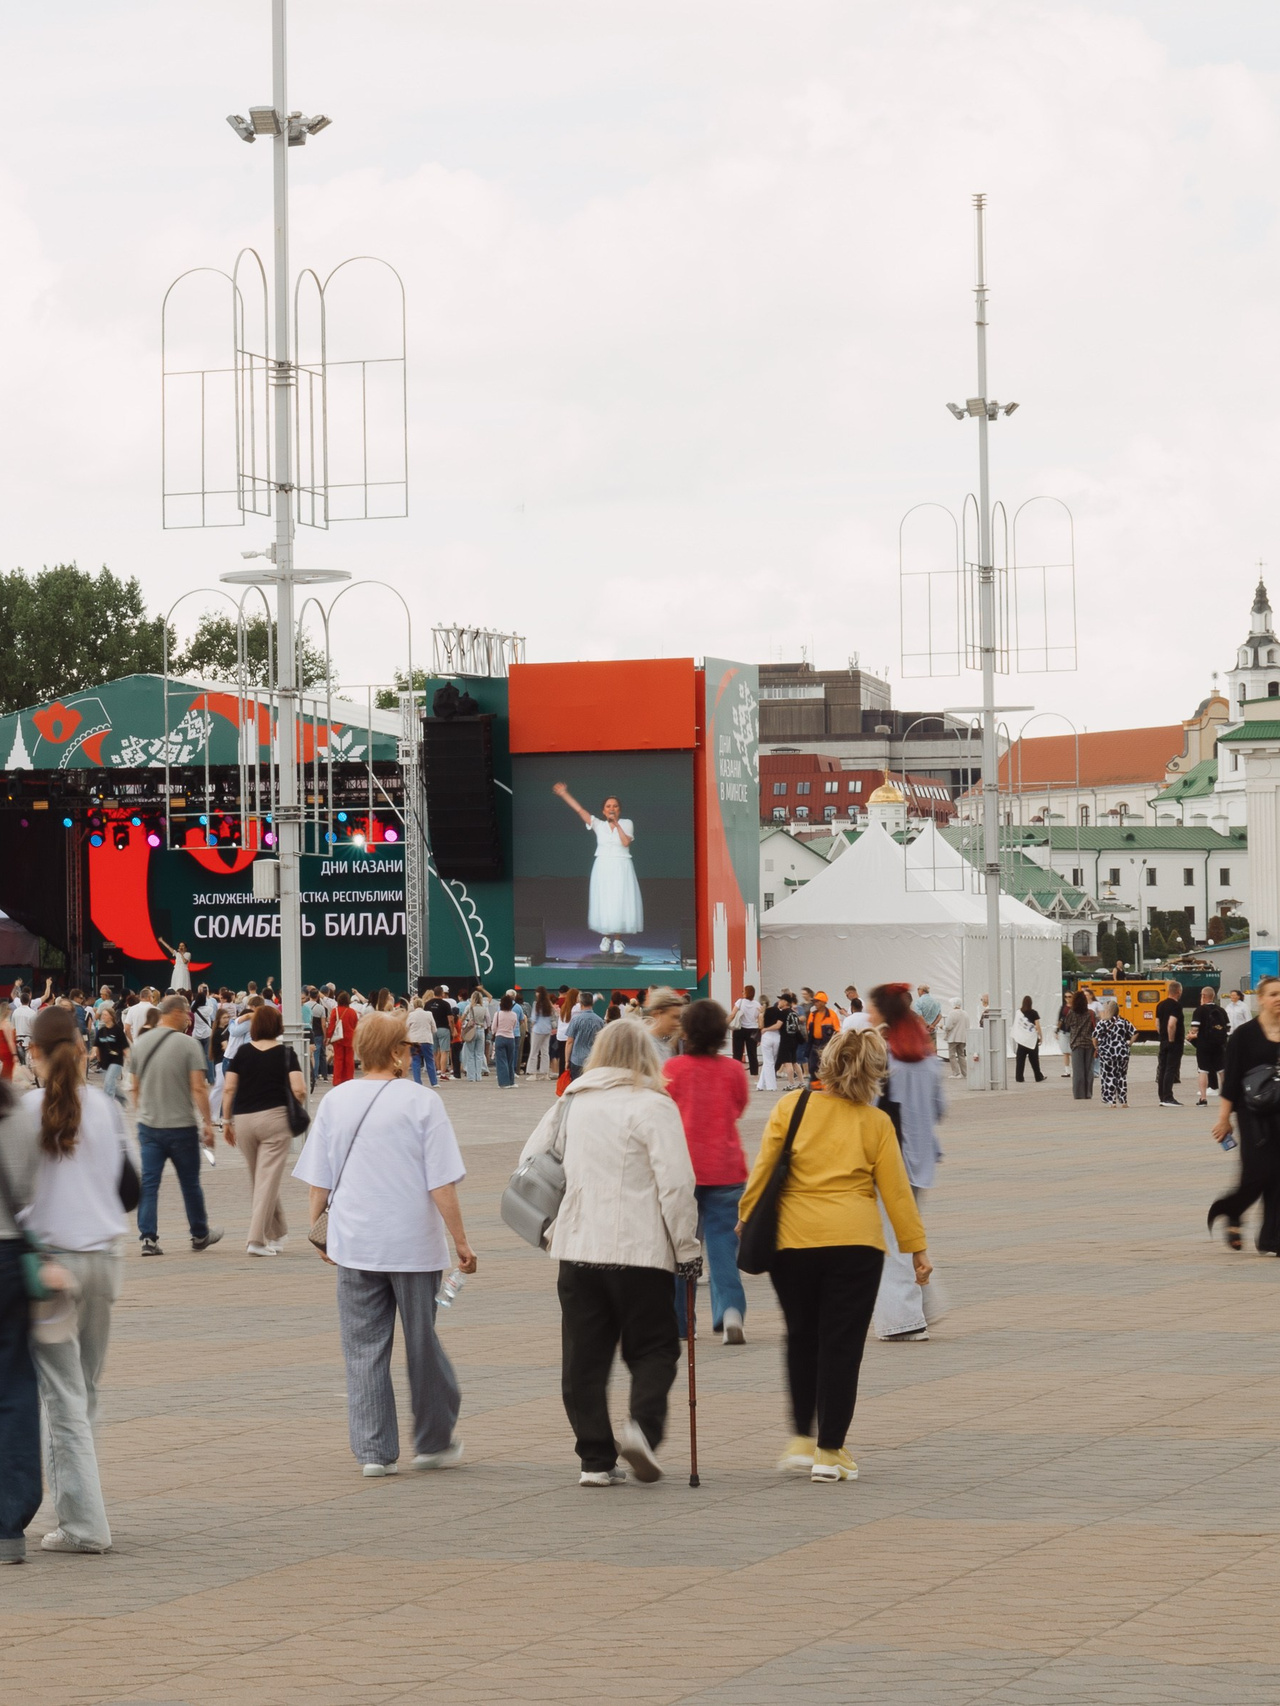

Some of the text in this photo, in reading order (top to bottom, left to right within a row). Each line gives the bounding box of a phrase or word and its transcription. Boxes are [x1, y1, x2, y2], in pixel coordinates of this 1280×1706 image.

[719, 734, 732, 757] ДНИ
[720, 758, 742, 779] КАЗАНИ
[720, 782, 748, 803] В МИНСКЕ
[321, 860, 403, 876] ДНИ КАЗАНИ
[332, 890, 403, 903] РЕСПУБЛИКИ
[194, 913, 316, 939] СЮМБЕЬ
